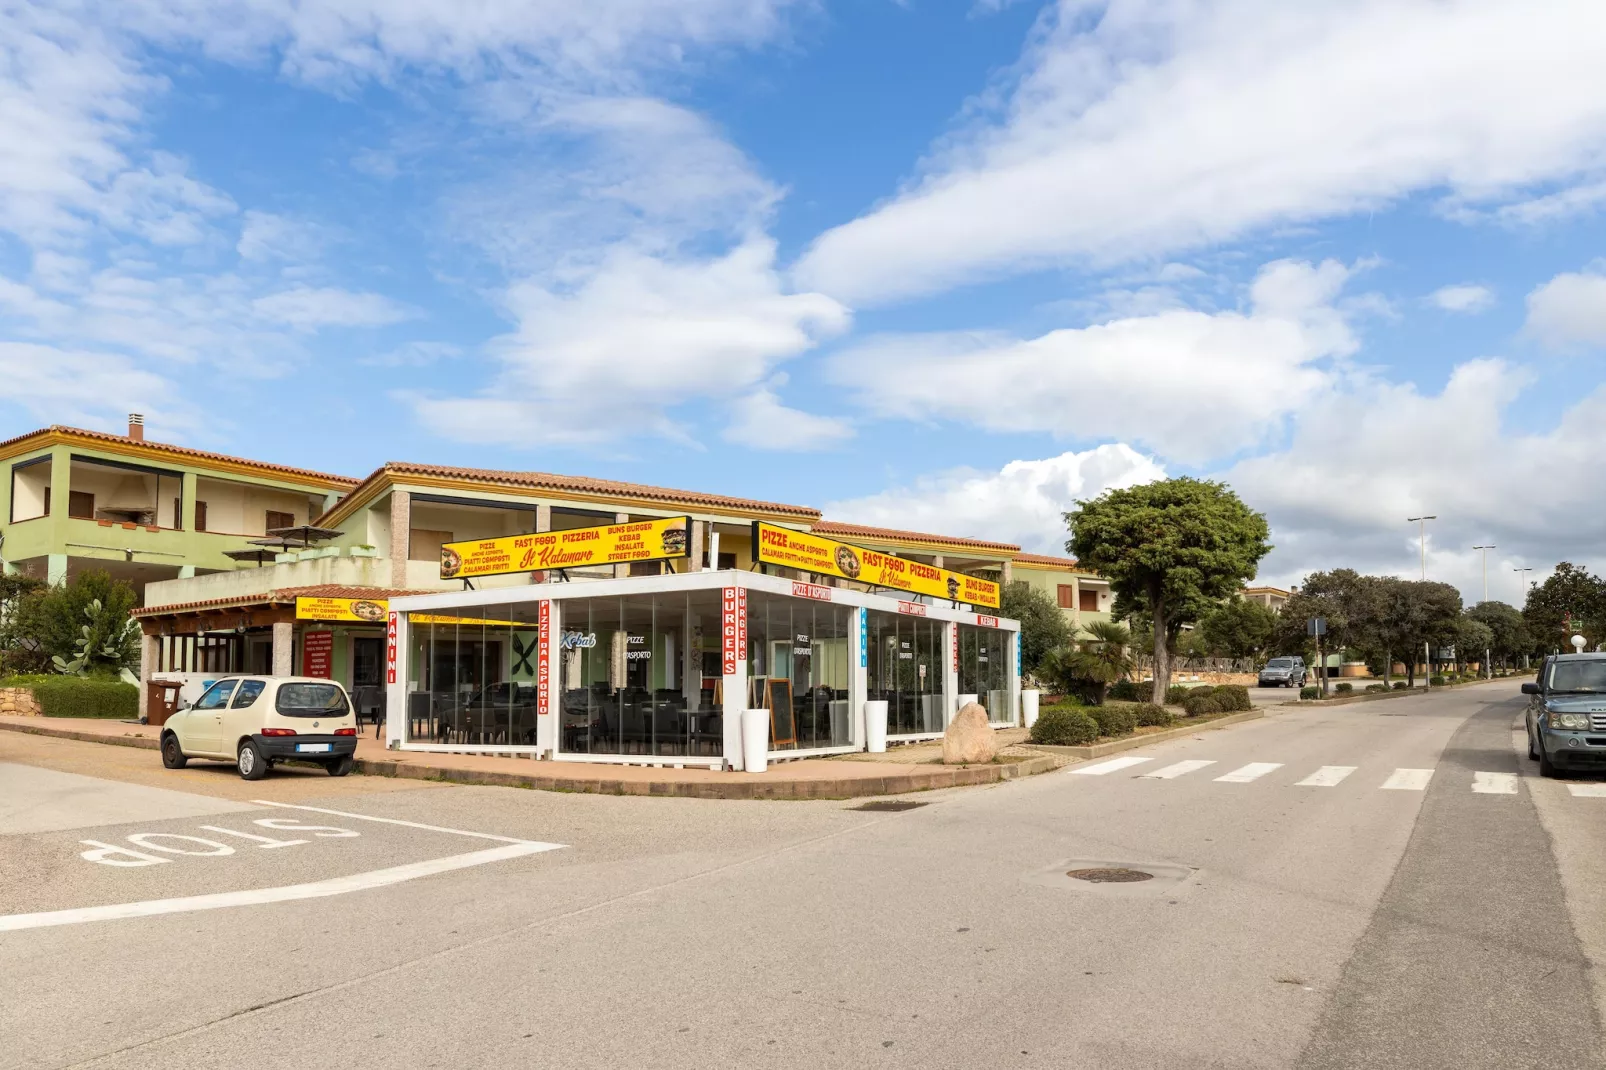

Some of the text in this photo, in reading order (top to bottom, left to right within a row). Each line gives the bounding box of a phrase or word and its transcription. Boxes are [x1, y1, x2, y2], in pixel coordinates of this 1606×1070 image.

[608, 524, 652, 534] BUNS BURGER
[514, 531, 600, 548] FAST FOOD PIZZERIA
[619, 533, 641, 542] KEBAB
[762, 529, 788, 548] PIZZE
[789, 541, 806, 552] ANCHE
[479, 542, 496, 550] PIZZE
[614, 542, 645, 551] INSALATE
[464, 554, 511, 565] PIATTI COMPOSTI
[608, 550, 651, 561] STREET FOOD
[464, 562, 510, 573] CALAMARI FRITTI
[863, 551, 942, 581] FAST FOOD PIZZERIA
[793, 583, 807, 596] PIZZE
[978, 581, 995, 593] BURGER
[981, 616, 997, 627] KEBAB
[725, 588, 735, 674] BURGERS
[560, 629, 597, 649] Kebab
[626, 636, 645, 644] PIZZE
[388, 612, 397, 683] PANINI
[540, 601, 549, 714] PIZZE DA ASPORTO
[79, 818, 361, 868] STOP
